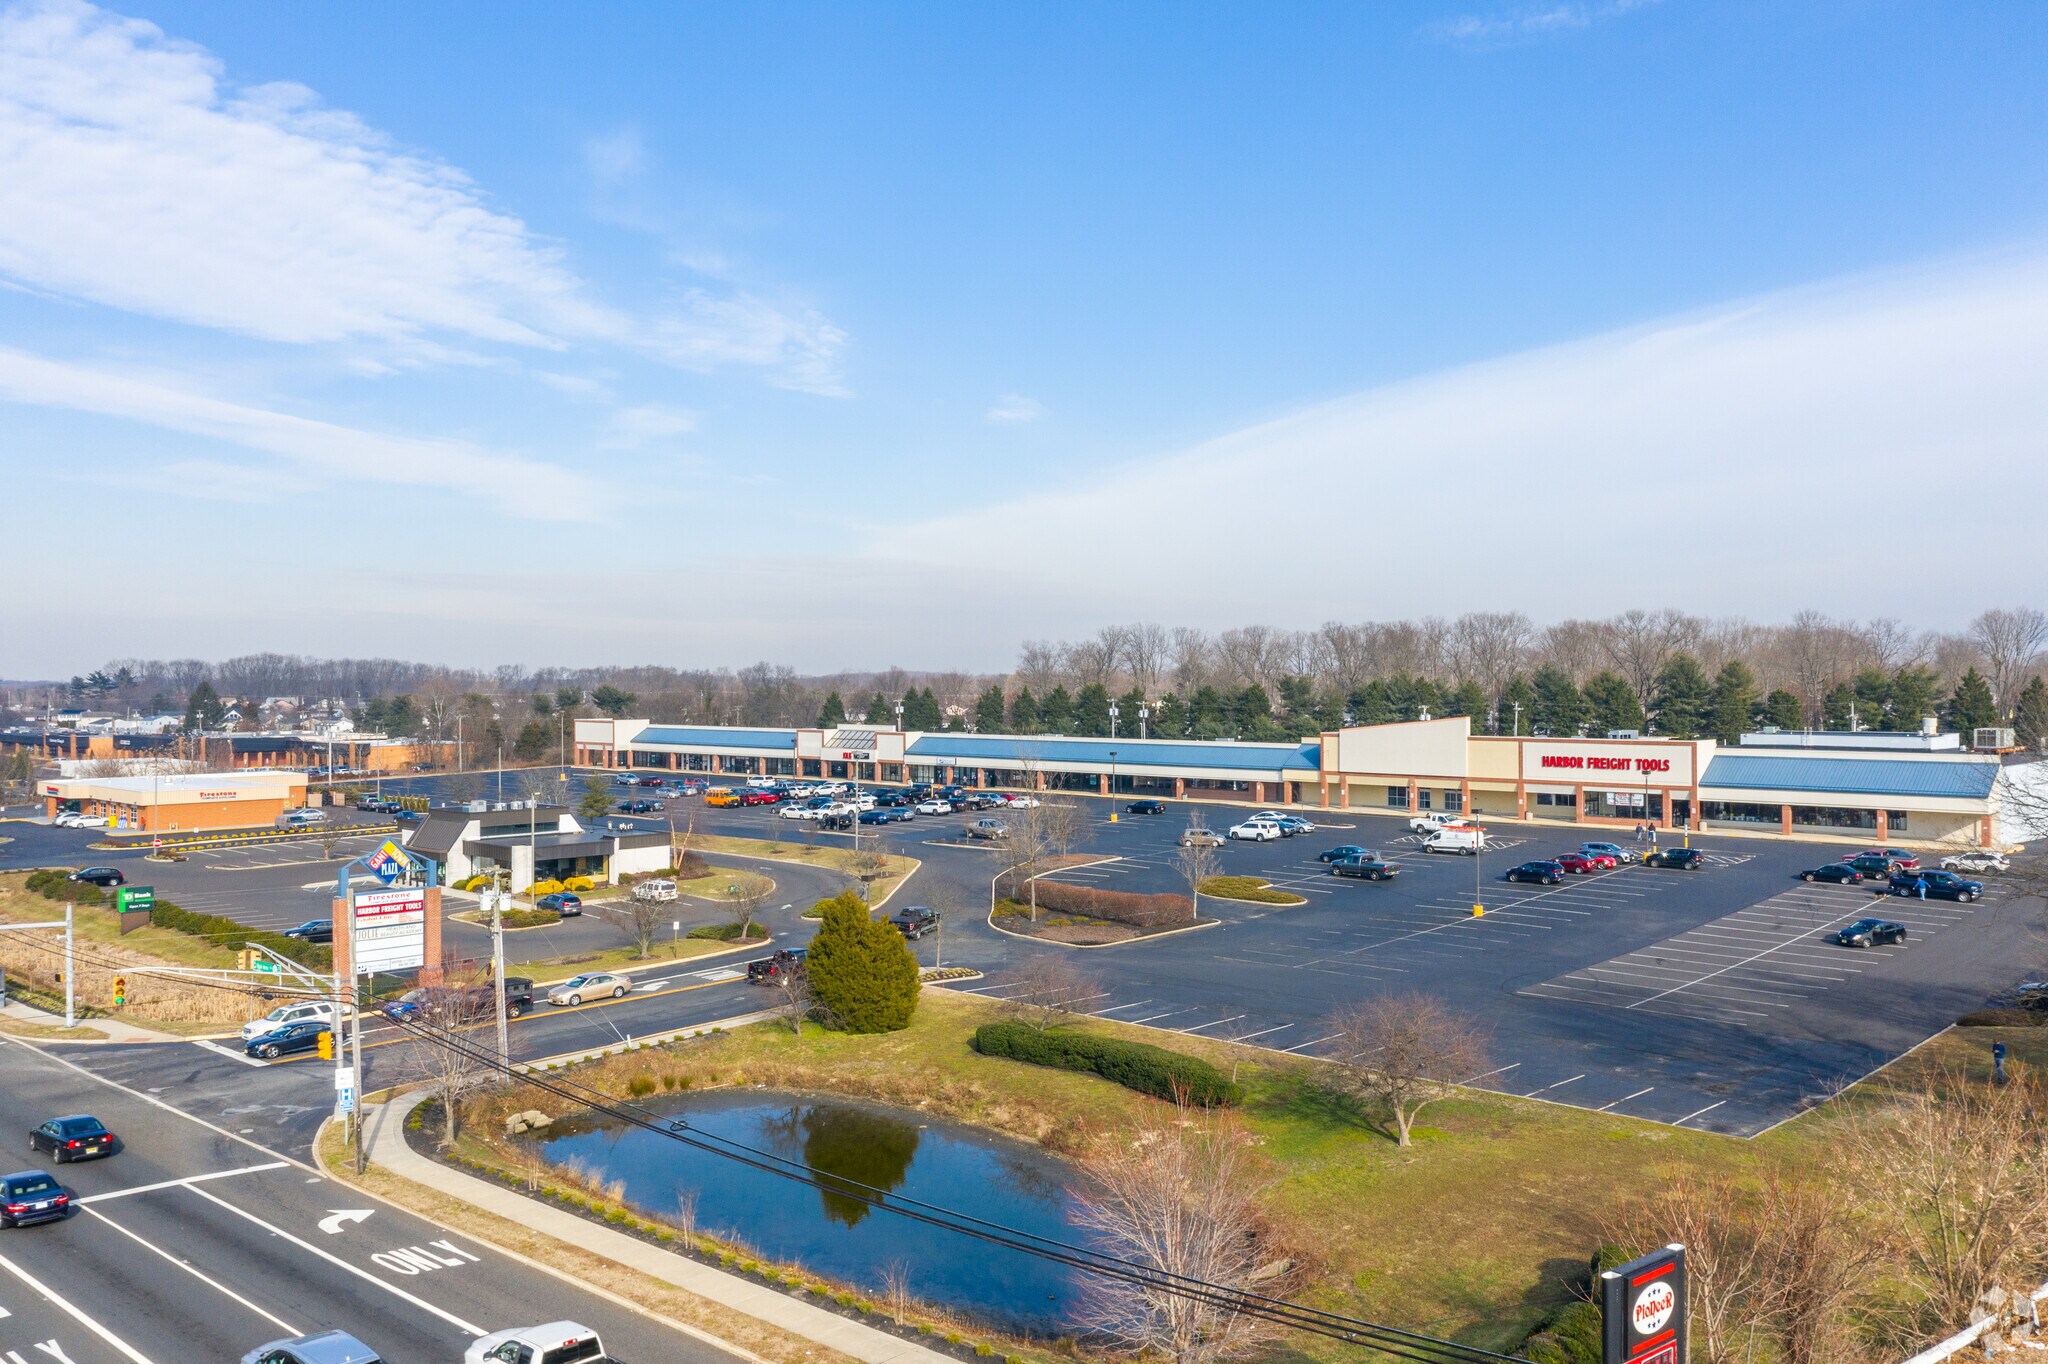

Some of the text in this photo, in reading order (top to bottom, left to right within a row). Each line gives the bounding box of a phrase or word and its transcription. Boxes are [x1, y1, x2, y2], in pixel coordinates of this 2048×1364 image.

[1541, 756, 1670, 772] HARBOR FREIGHT TOOLS
[370, 850, 388, 870] GANT
[391, 848, 409, 867] TOWN
[381, 862, 399, 876] PLAZA
[122, 893, 133, 901] TD
[368, 893, 411, 902] Firestone
[357, 902, 422, 915] HARBOR FREIGHT TOOLS
[358, 929, 378, 939] JOLIE
[341, 1089, 352, 1100] H
[371, 1240, 480, 1275] ONLY
